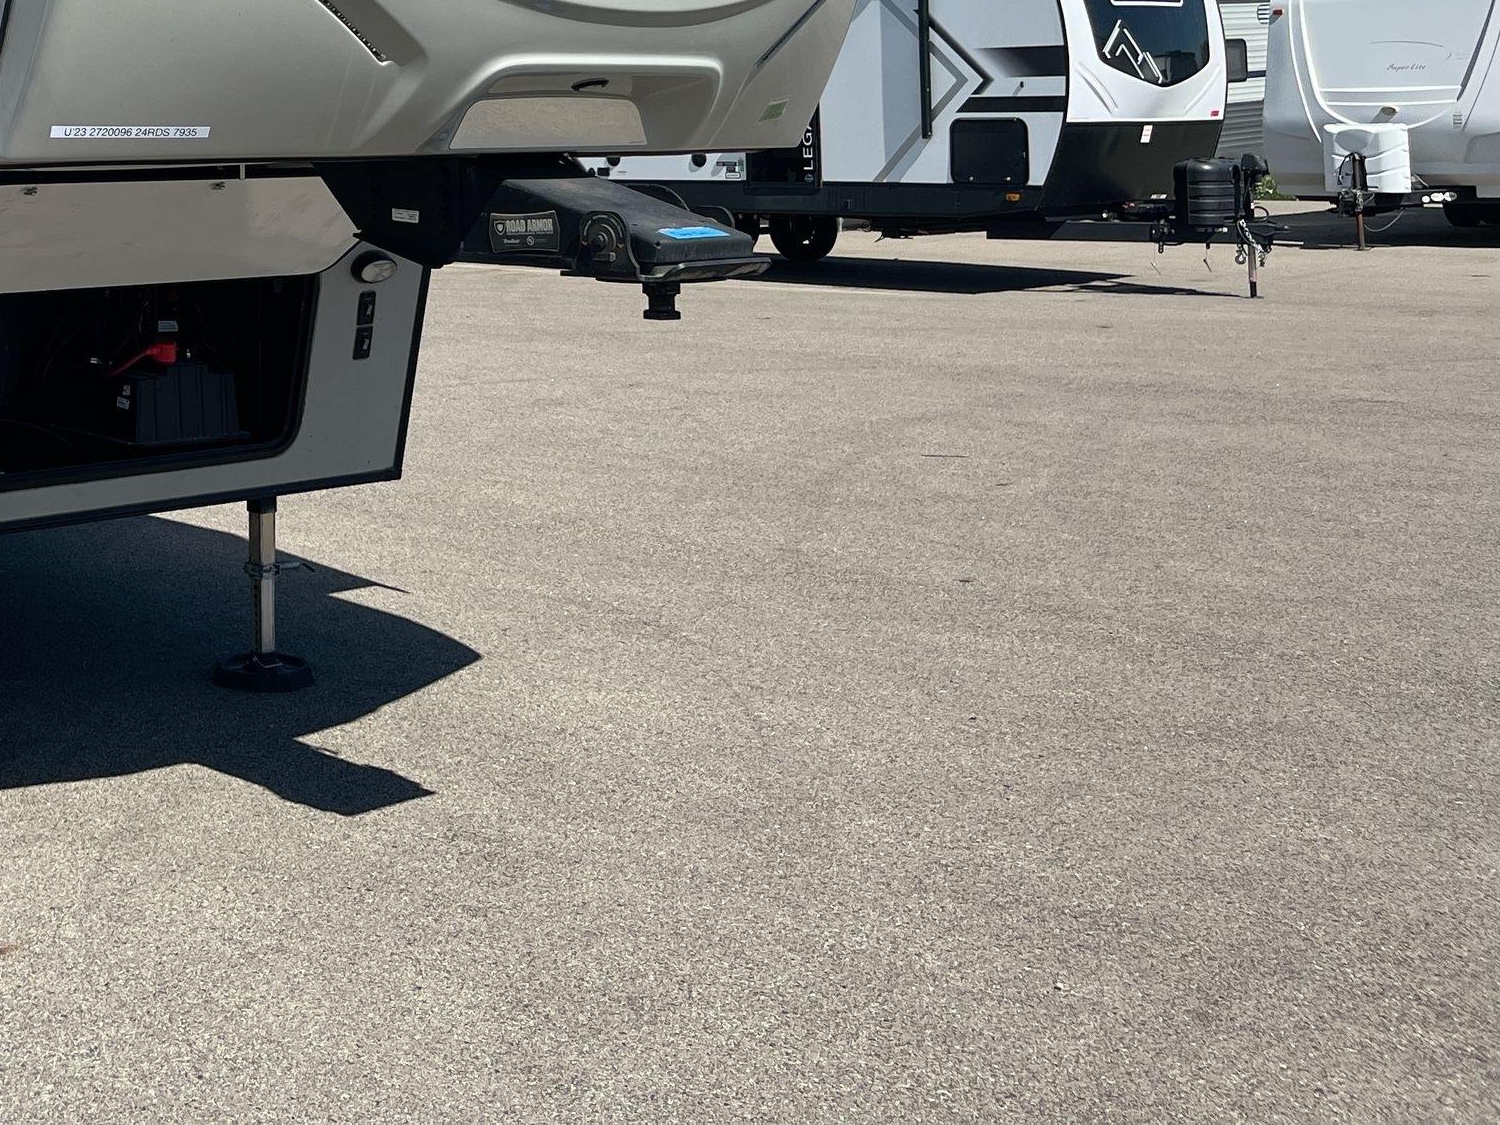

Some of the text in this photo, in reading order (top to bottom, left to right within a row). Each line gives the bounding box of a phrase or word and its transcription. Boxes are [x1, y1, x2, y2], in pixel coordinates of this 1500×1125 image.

[89, 127, 133, 137] 2720096
[135, 127, 171, 137] 24RDS
[173, 127, 198, 137] 7935
[505, 218, 554, 232] ROAD ARMOR
